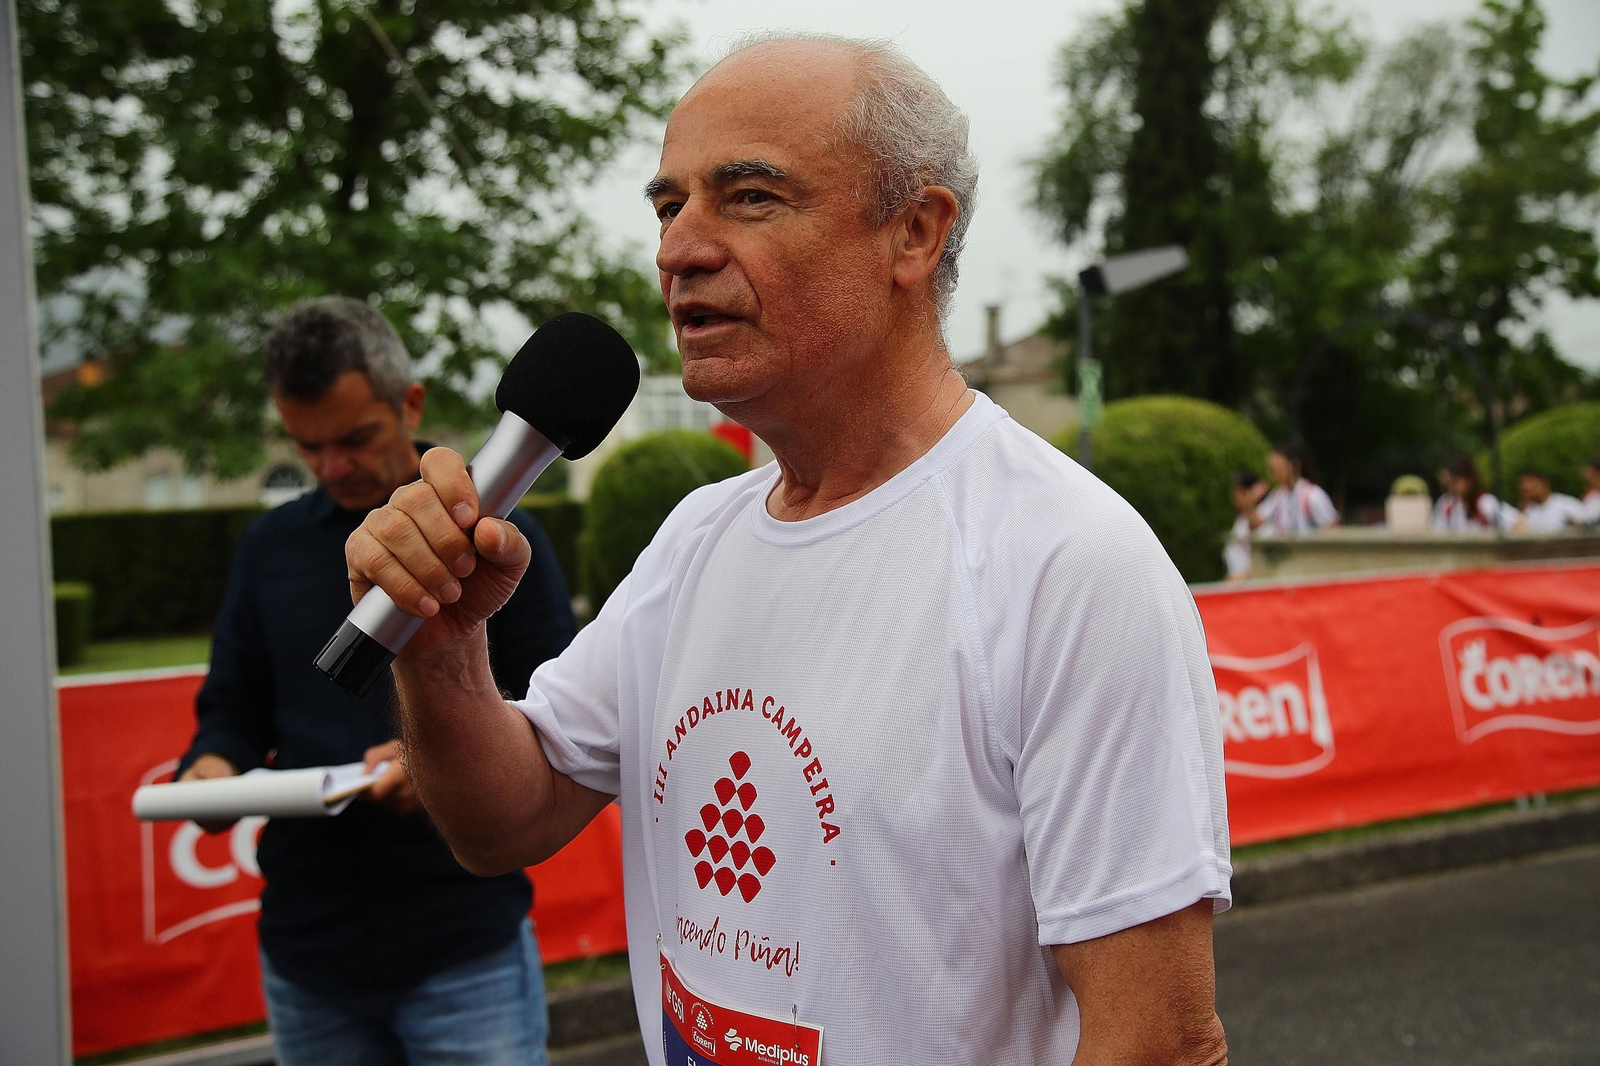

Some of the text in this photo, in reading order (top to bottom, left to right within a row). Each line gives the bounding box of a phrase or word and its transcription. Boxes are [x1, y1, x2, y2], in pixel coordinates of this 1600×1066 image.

[653, 687, 841, 844] III ANDAINA CAMPEIRA
[734, 929, 800, 977] Piña!
[745, 1036, 810, 1066] Mediplus
